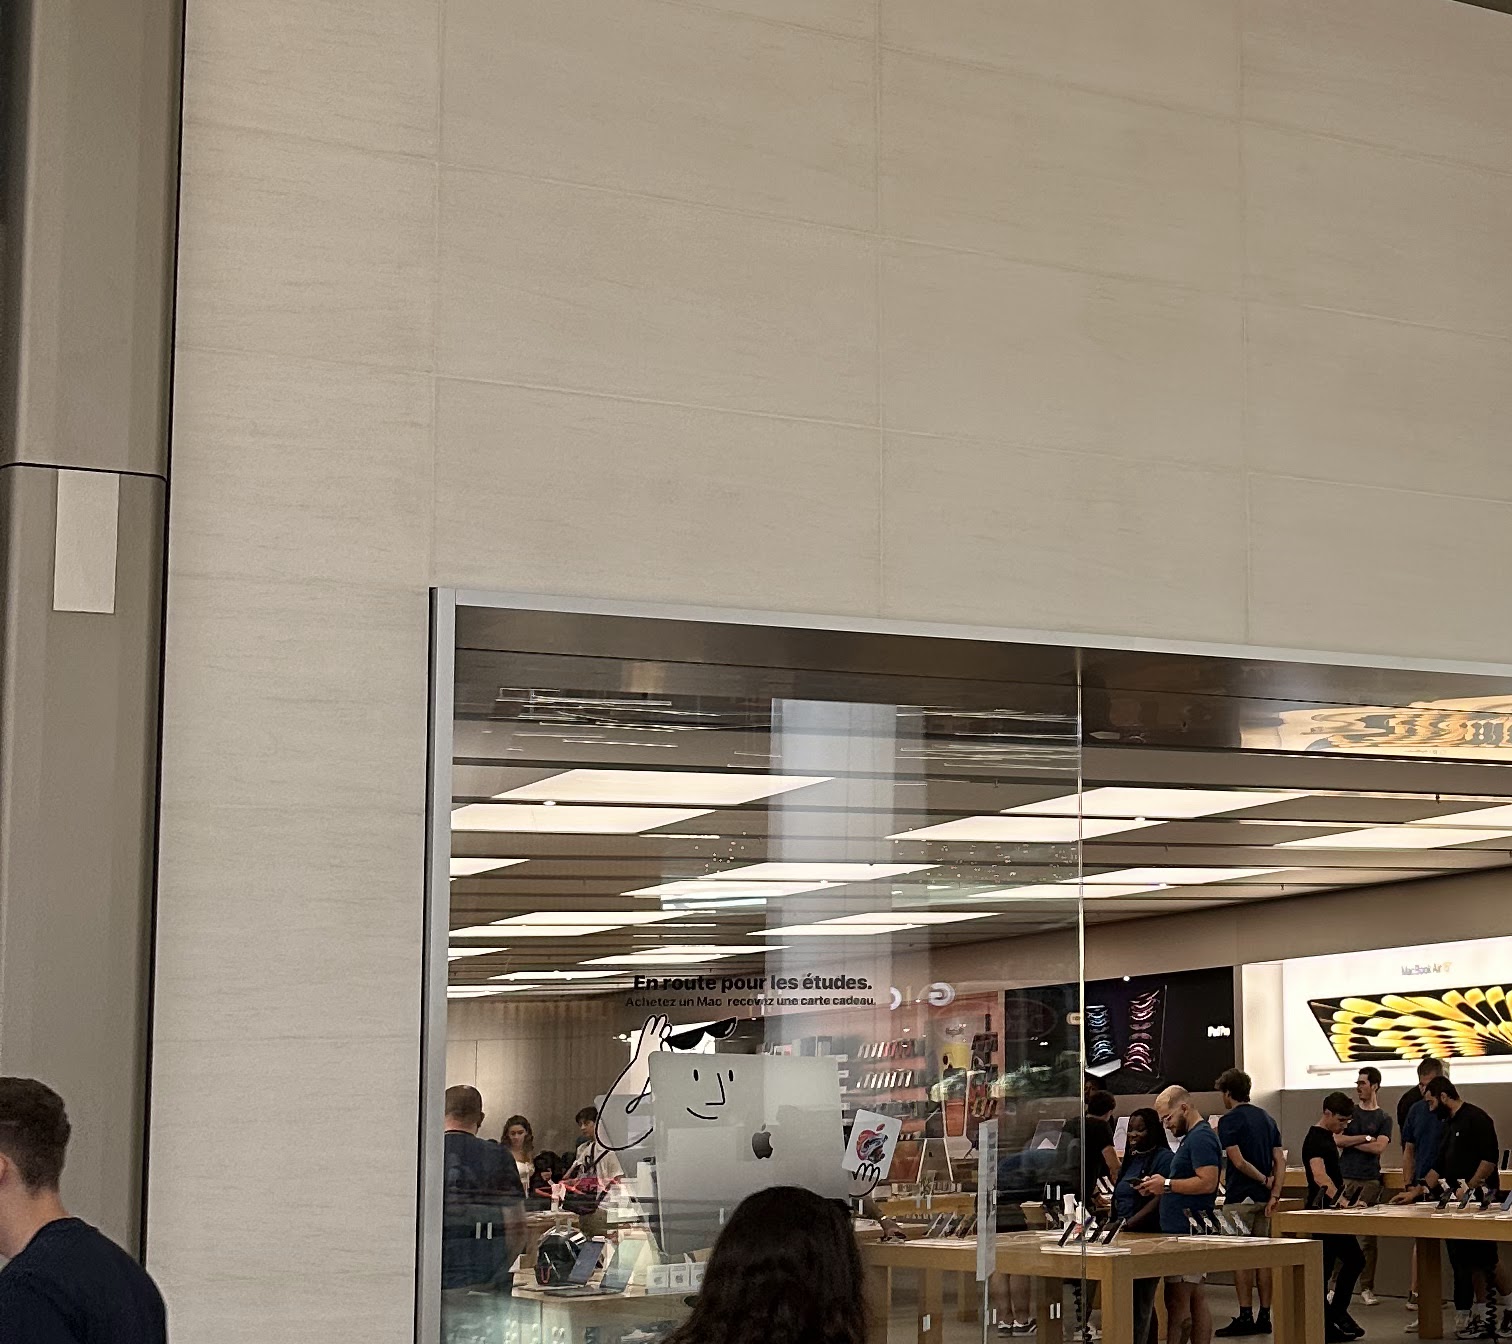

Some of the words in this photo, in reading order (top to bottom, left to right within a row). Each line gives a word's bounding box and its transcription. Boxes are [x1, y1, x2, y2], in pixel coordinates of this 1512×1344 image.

[633, 974, 658, 990] En
[663, 975, 717, 990] route
[721, 976, 767, 993] pour
[770, 974, 799, 990] les
[802, 972, 873, 990] études.
[625, 996, 677, 1007] Achetez
[678, 998, 697, 1007] un
[776, 997, 799, 1006] une
[800, 996, 831, 1006] carte
